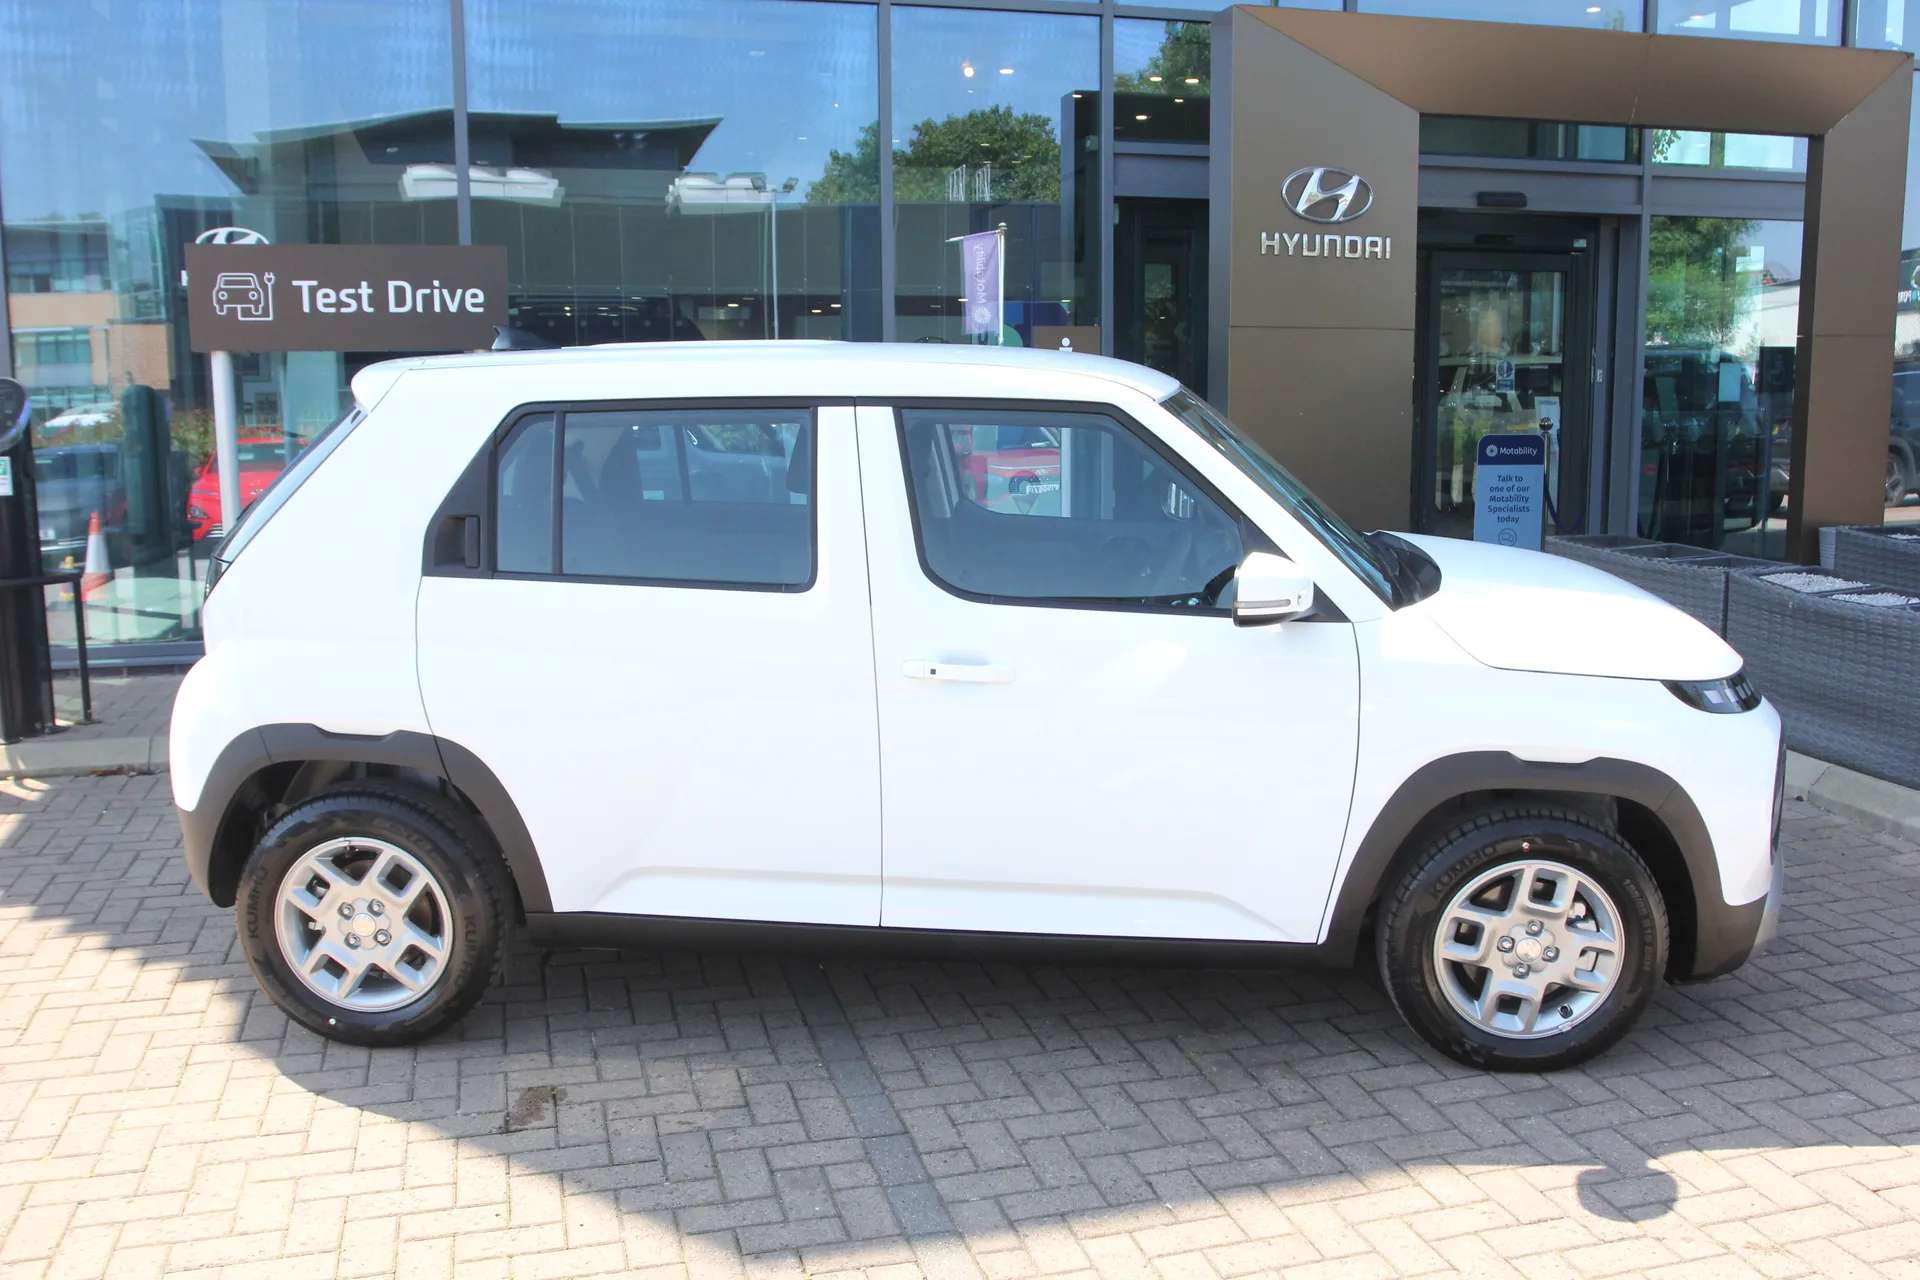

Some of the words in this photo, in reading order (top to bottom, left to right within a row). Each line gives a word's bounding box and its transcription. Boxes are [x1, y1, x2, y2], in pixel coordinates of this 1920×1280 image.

[1260, 231, 1392, 260] HYUNDAI
[291, 279, 375, 314] Test
[387, 279, 486, 314] Drive
[1499, 447, 1538, 457] Motability
[1497, 474, 1513, 482] Talk
[1505, 484, 1515, 493] of
[1489, 495, 1530, 504] Motability
[1487, 504, 1530, 514] Specialists
[1497, 515, 1520, 524] today
